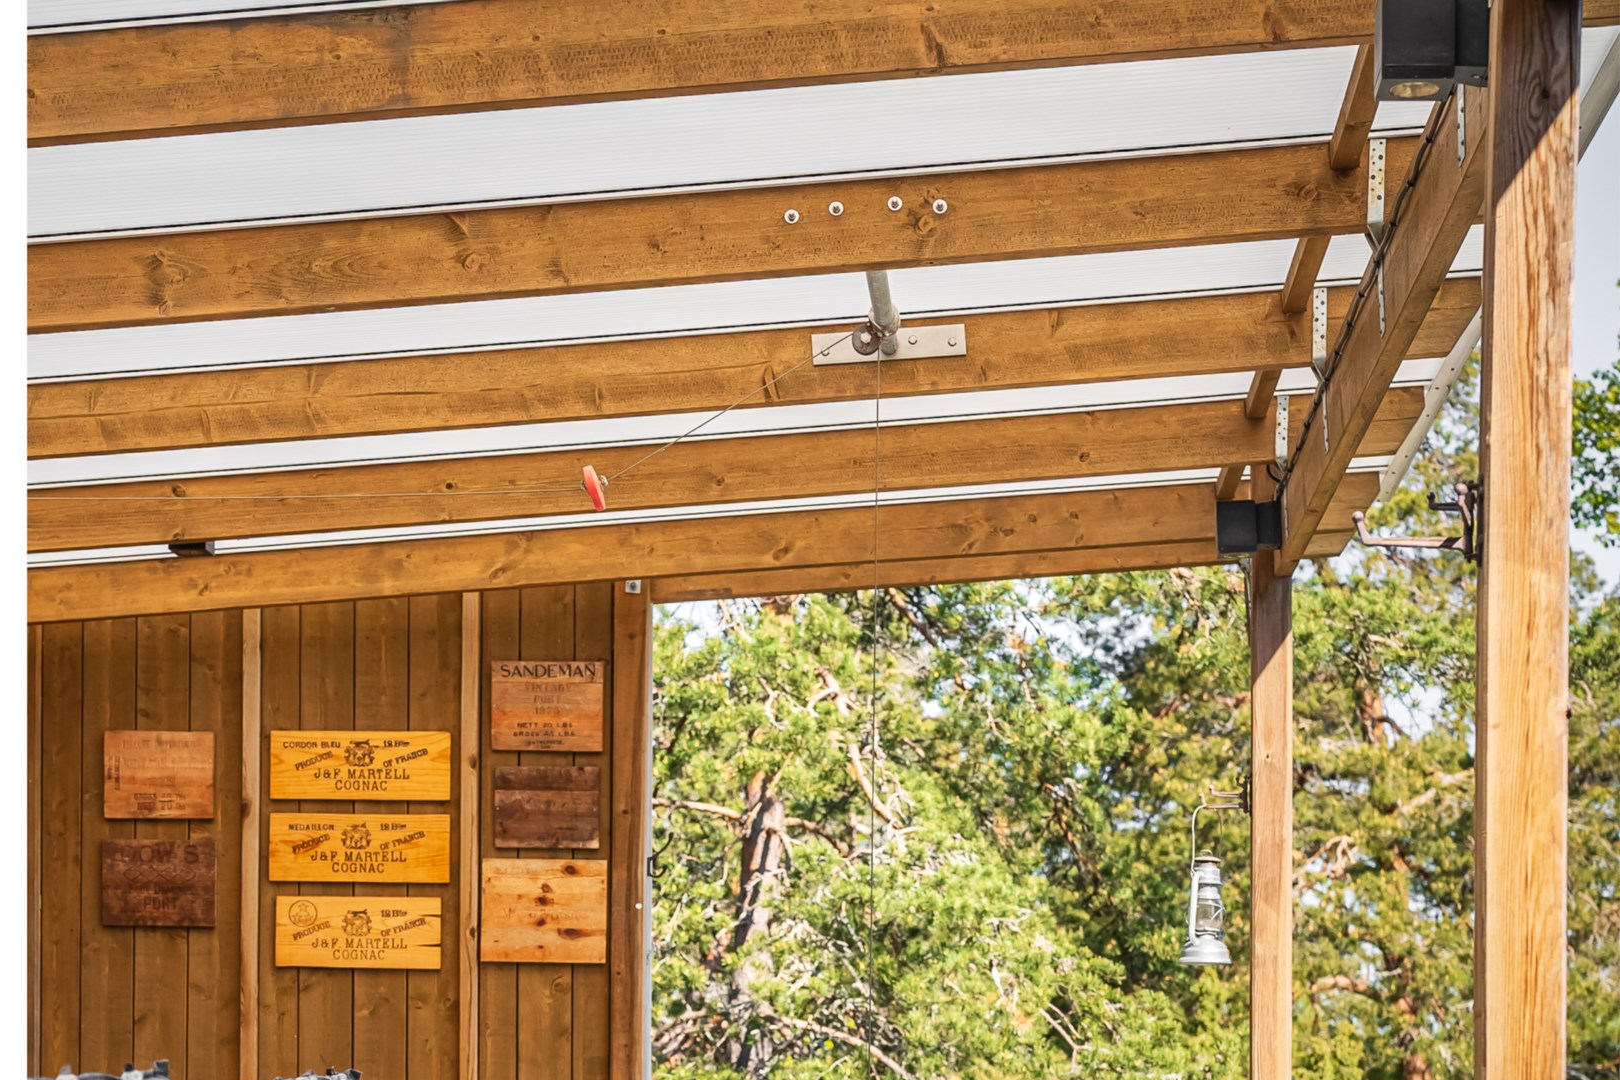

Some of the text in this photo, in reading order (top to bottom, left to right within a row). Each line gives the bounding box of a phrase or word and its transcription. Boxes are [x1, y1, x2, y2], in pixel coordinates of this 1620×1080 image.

[500, 663, 596, 678] SANDEMAN
[283, 740, 341, 749] CORDON BLEU
[294, 750, 334, 771] PRODUCE
[383, 748, 429, 768] OF FRANCE
[347, 768, 410, 780] MARTELL
[334, 780, 388, 791] COGNAC
[288, 823, 335, 832] MEDAILLON
[292, 833, 331, 854] PRODUCE
[380, 831, 426, 851] OF FRANCE
[344, 851, 407, 863] MARTELL
[332, 862, 385, 874] COGNAC
[143, 896, 179, 910] PORT
[292, 921, 331, 941] PRODUCE
[381, 918, 427, 938] OF FRANCE
[345, 938, 408, 950] MARTELL
[332, 949, 386, 961] COGNAC
